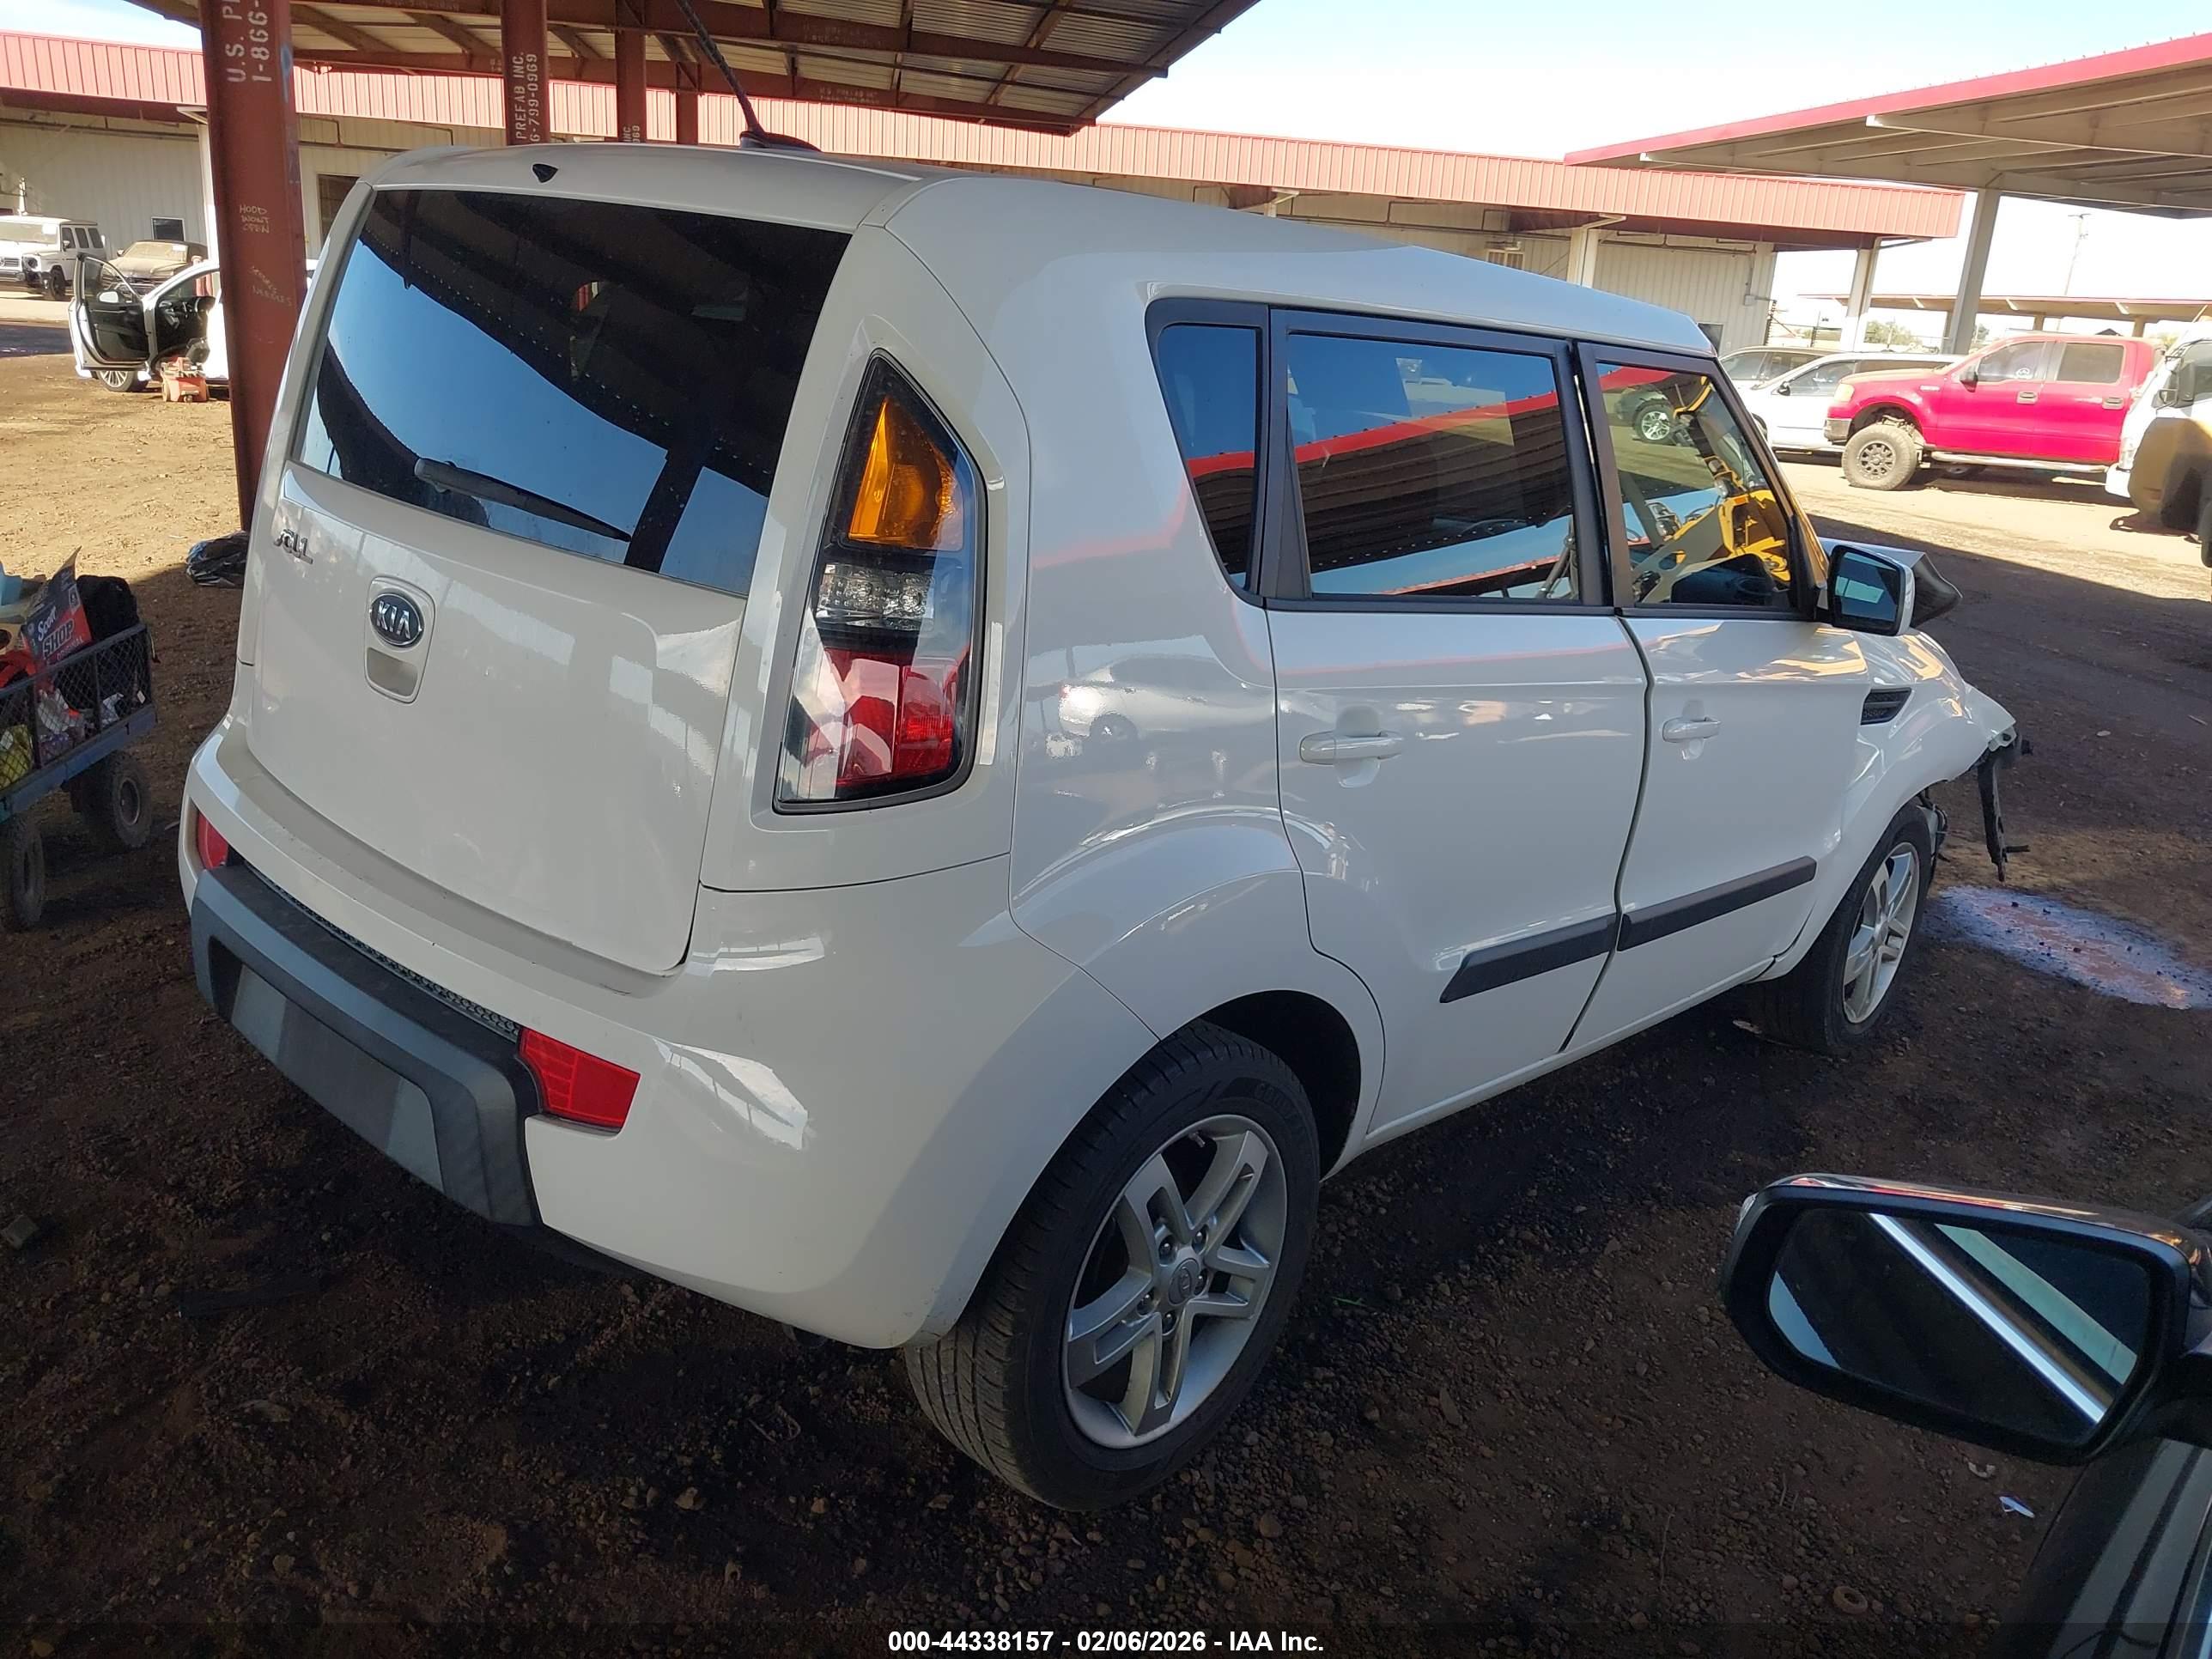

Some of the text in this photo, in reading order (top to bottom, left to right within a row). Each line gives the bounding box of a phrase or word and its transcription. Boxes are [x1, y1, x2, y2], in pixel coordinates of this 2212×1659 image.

[222, 0, 246, 82] U.S. P
[513, 52, 526, 139] PREFAB INC.
[43, 618, 75, 659] SHOP
[376, 600, 411, 640] KIA
